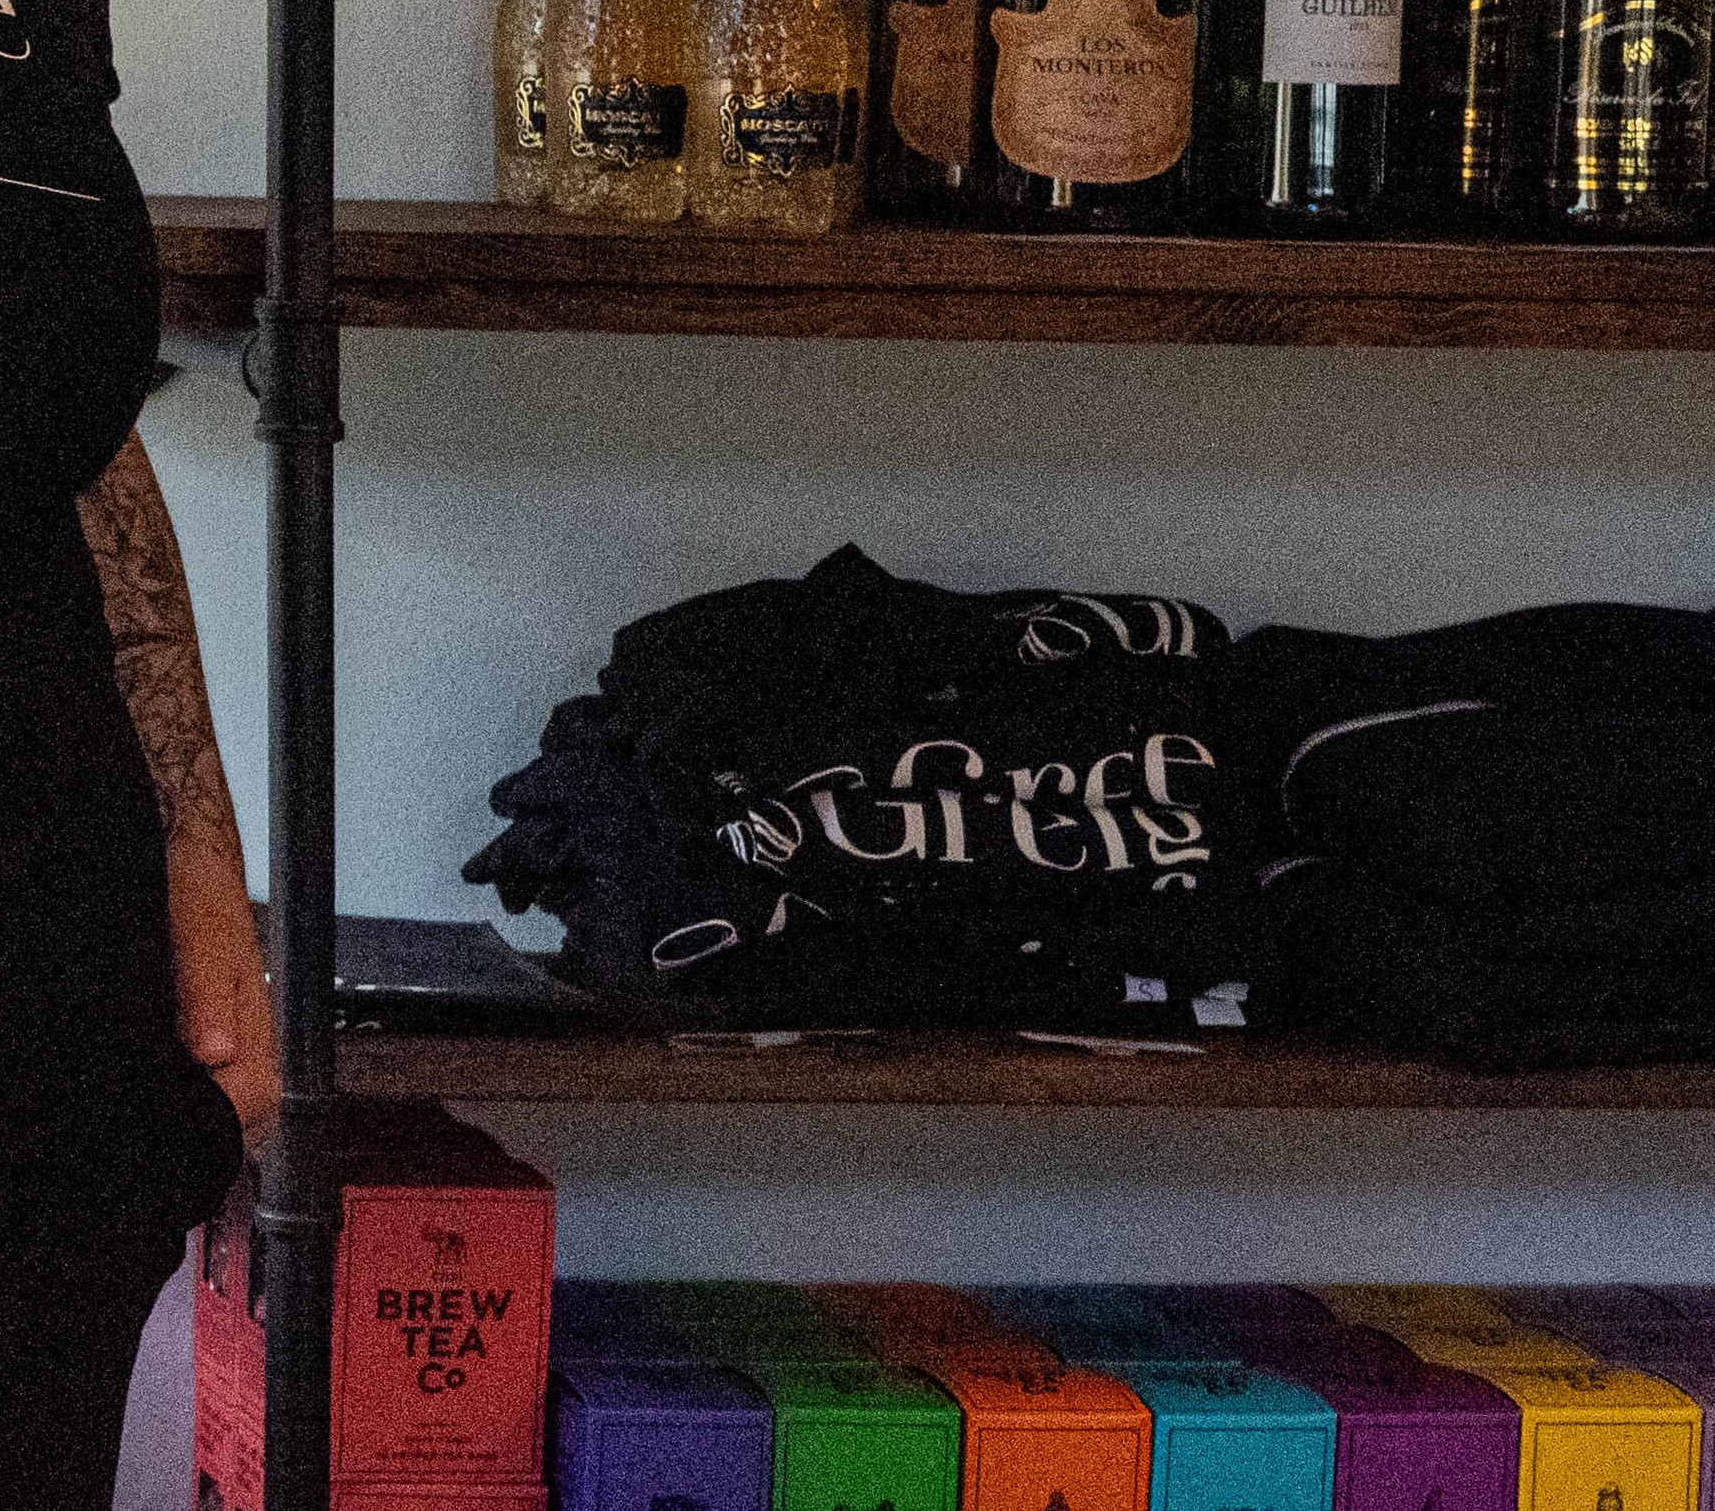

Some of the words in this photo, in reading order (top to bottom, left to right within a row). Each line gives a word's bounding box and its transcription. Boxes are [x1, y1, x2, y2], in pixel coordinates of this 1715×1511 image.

[1080, 36, 1126, 53] LOS
[1032, 57, 1167, 76] MONTEROS
[376, 1289, 513, 1322] BREW
[401, 1327, 486, 1358] TEA
[418, 1363, 467, 1394] Co
